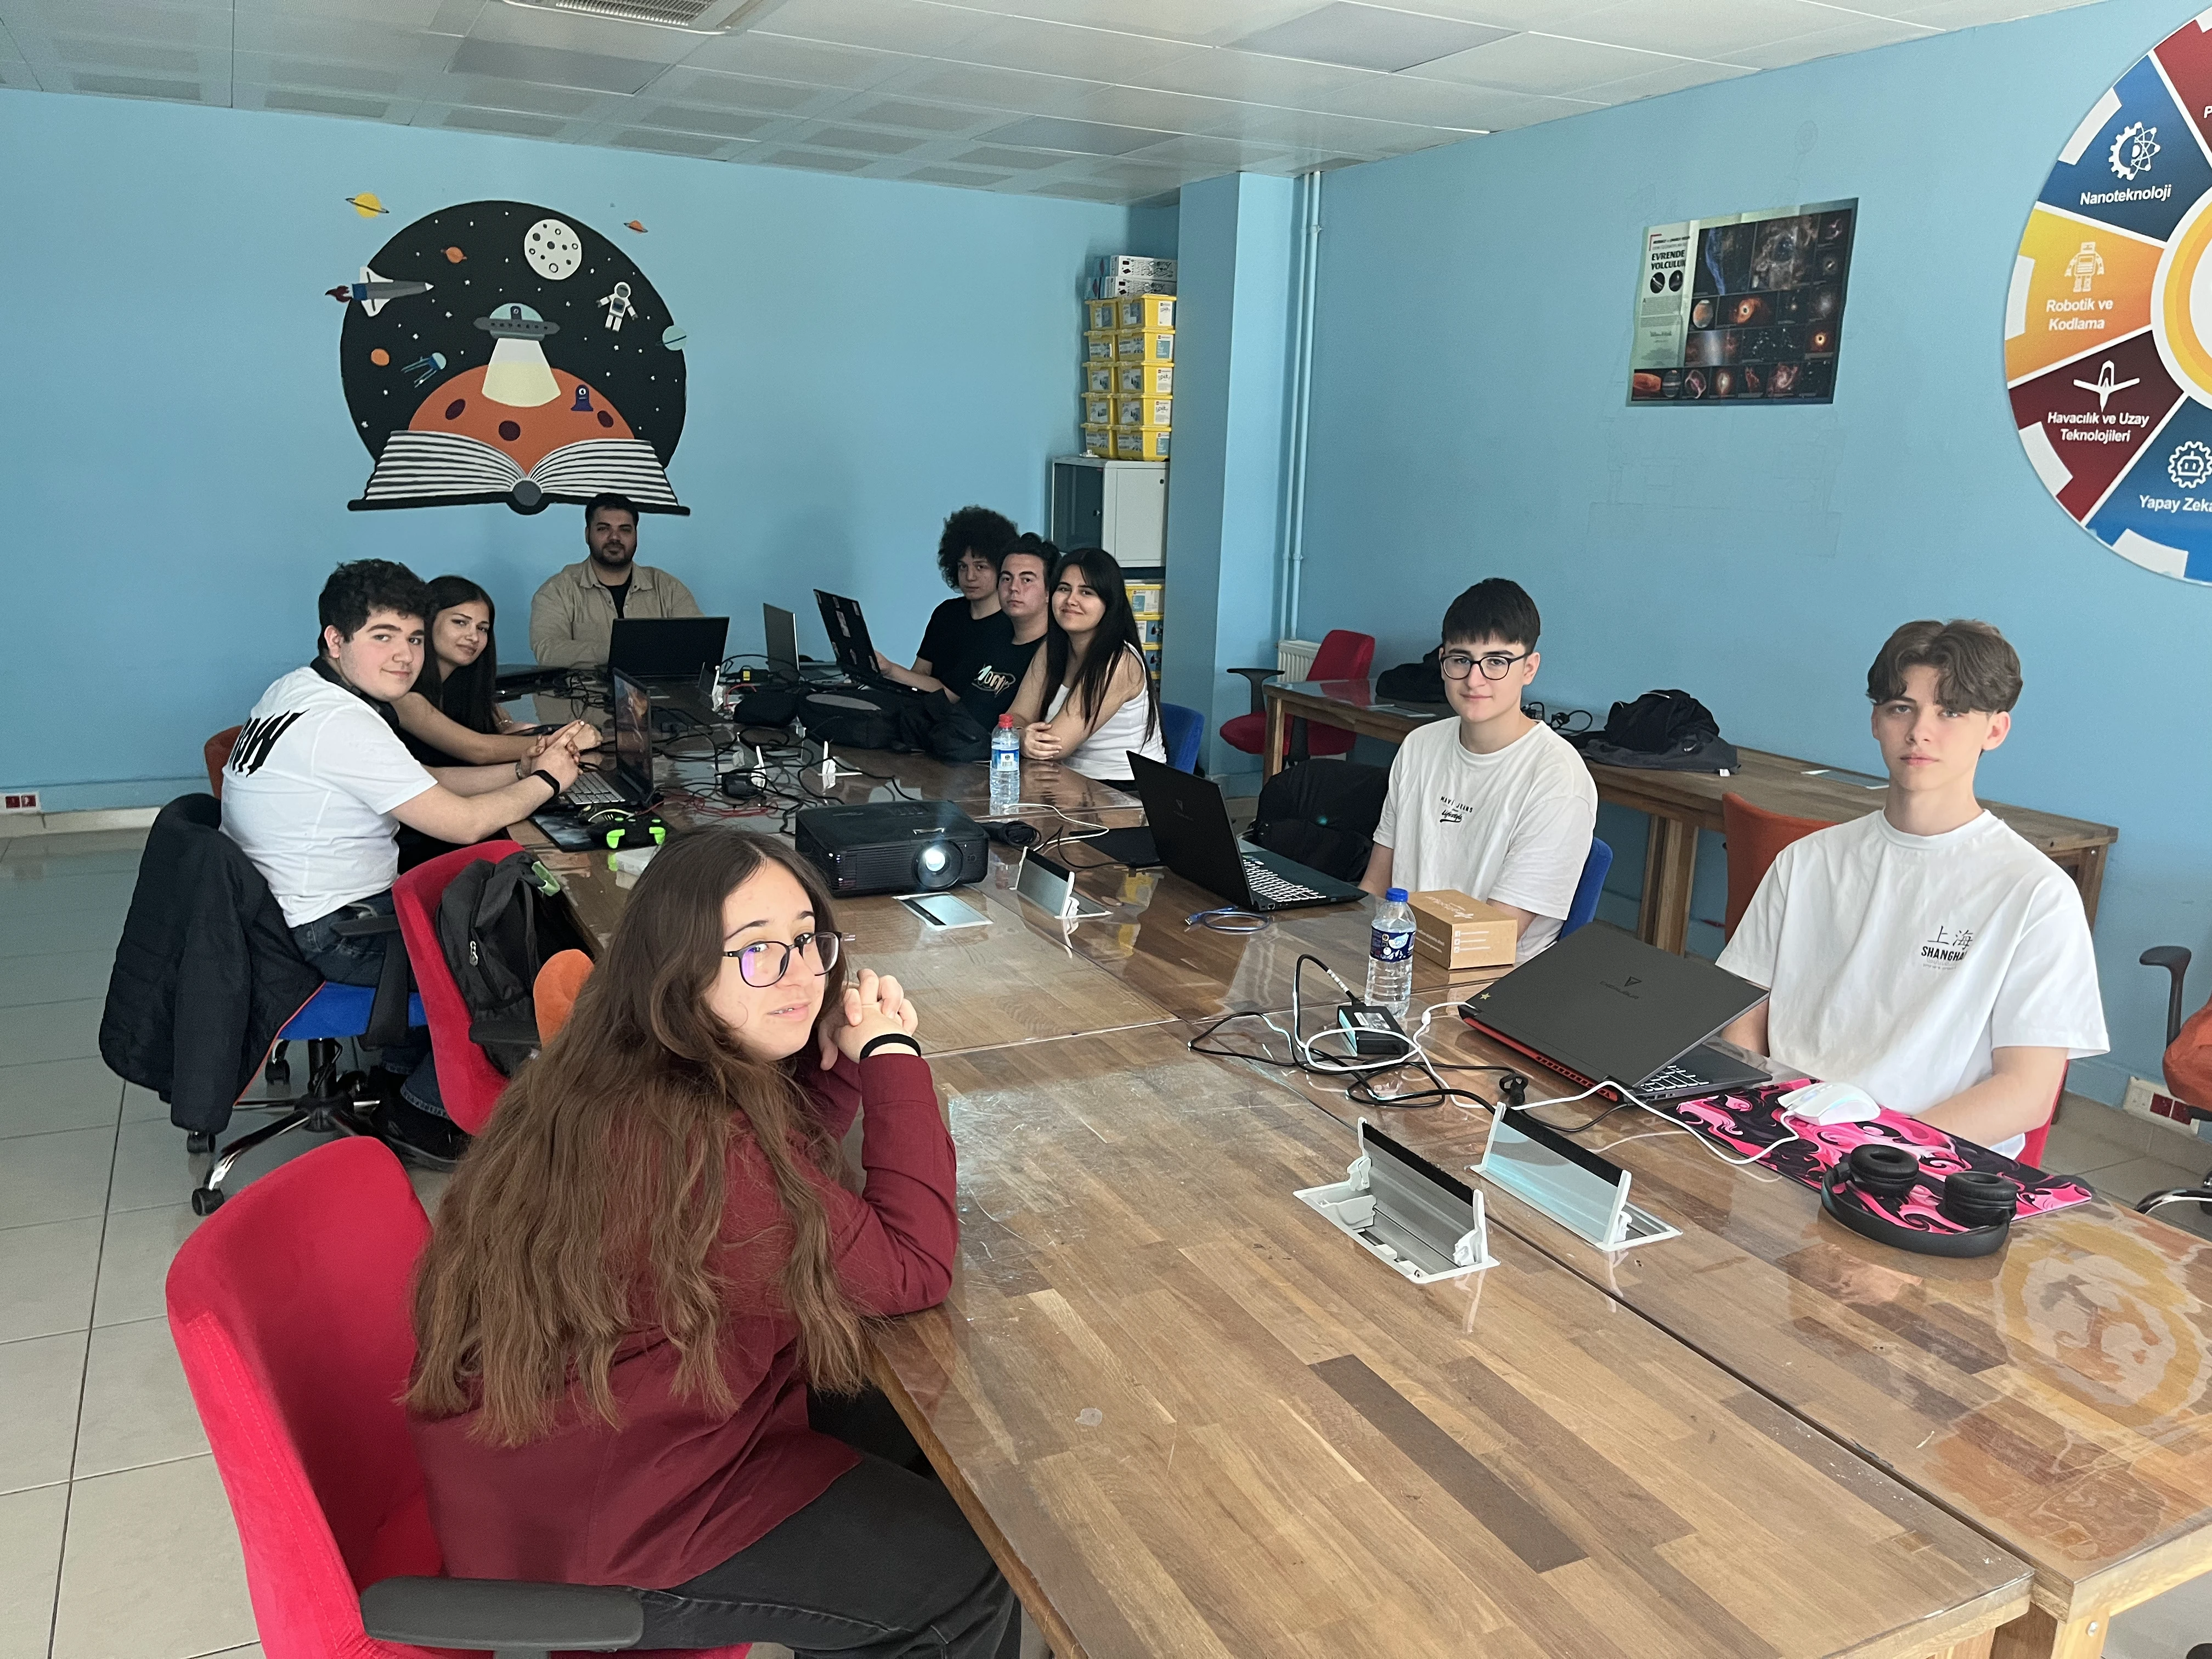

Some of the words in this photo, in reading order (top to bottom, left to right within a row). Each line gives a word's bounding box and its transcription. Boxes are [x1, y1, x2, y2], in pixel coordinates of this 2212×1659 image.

[2080, 184, 2172, 205] Nanoteknoloji
[1651, 250, 1685, 261] EVRENDE
[2046, 298, 2095, 313] Robotik
[2098, 300, 2113, 311] ve
[2049, 317, 2105, 331] Kodlama
[2047, 411, 2100, 424] Havacılık
[2102, 414, 2116, 425] ve
[2119, 412, 2149, 428] Uzay
[2060, 428, 2131, 444] Teknolojileri
[2140, 494, 2181, 514] Yapay
[1440, 796, 1455, 806] MAVI
[1456, 803, 1473, 813] JEANS
[1927, 925, 1973, 950] 上海
